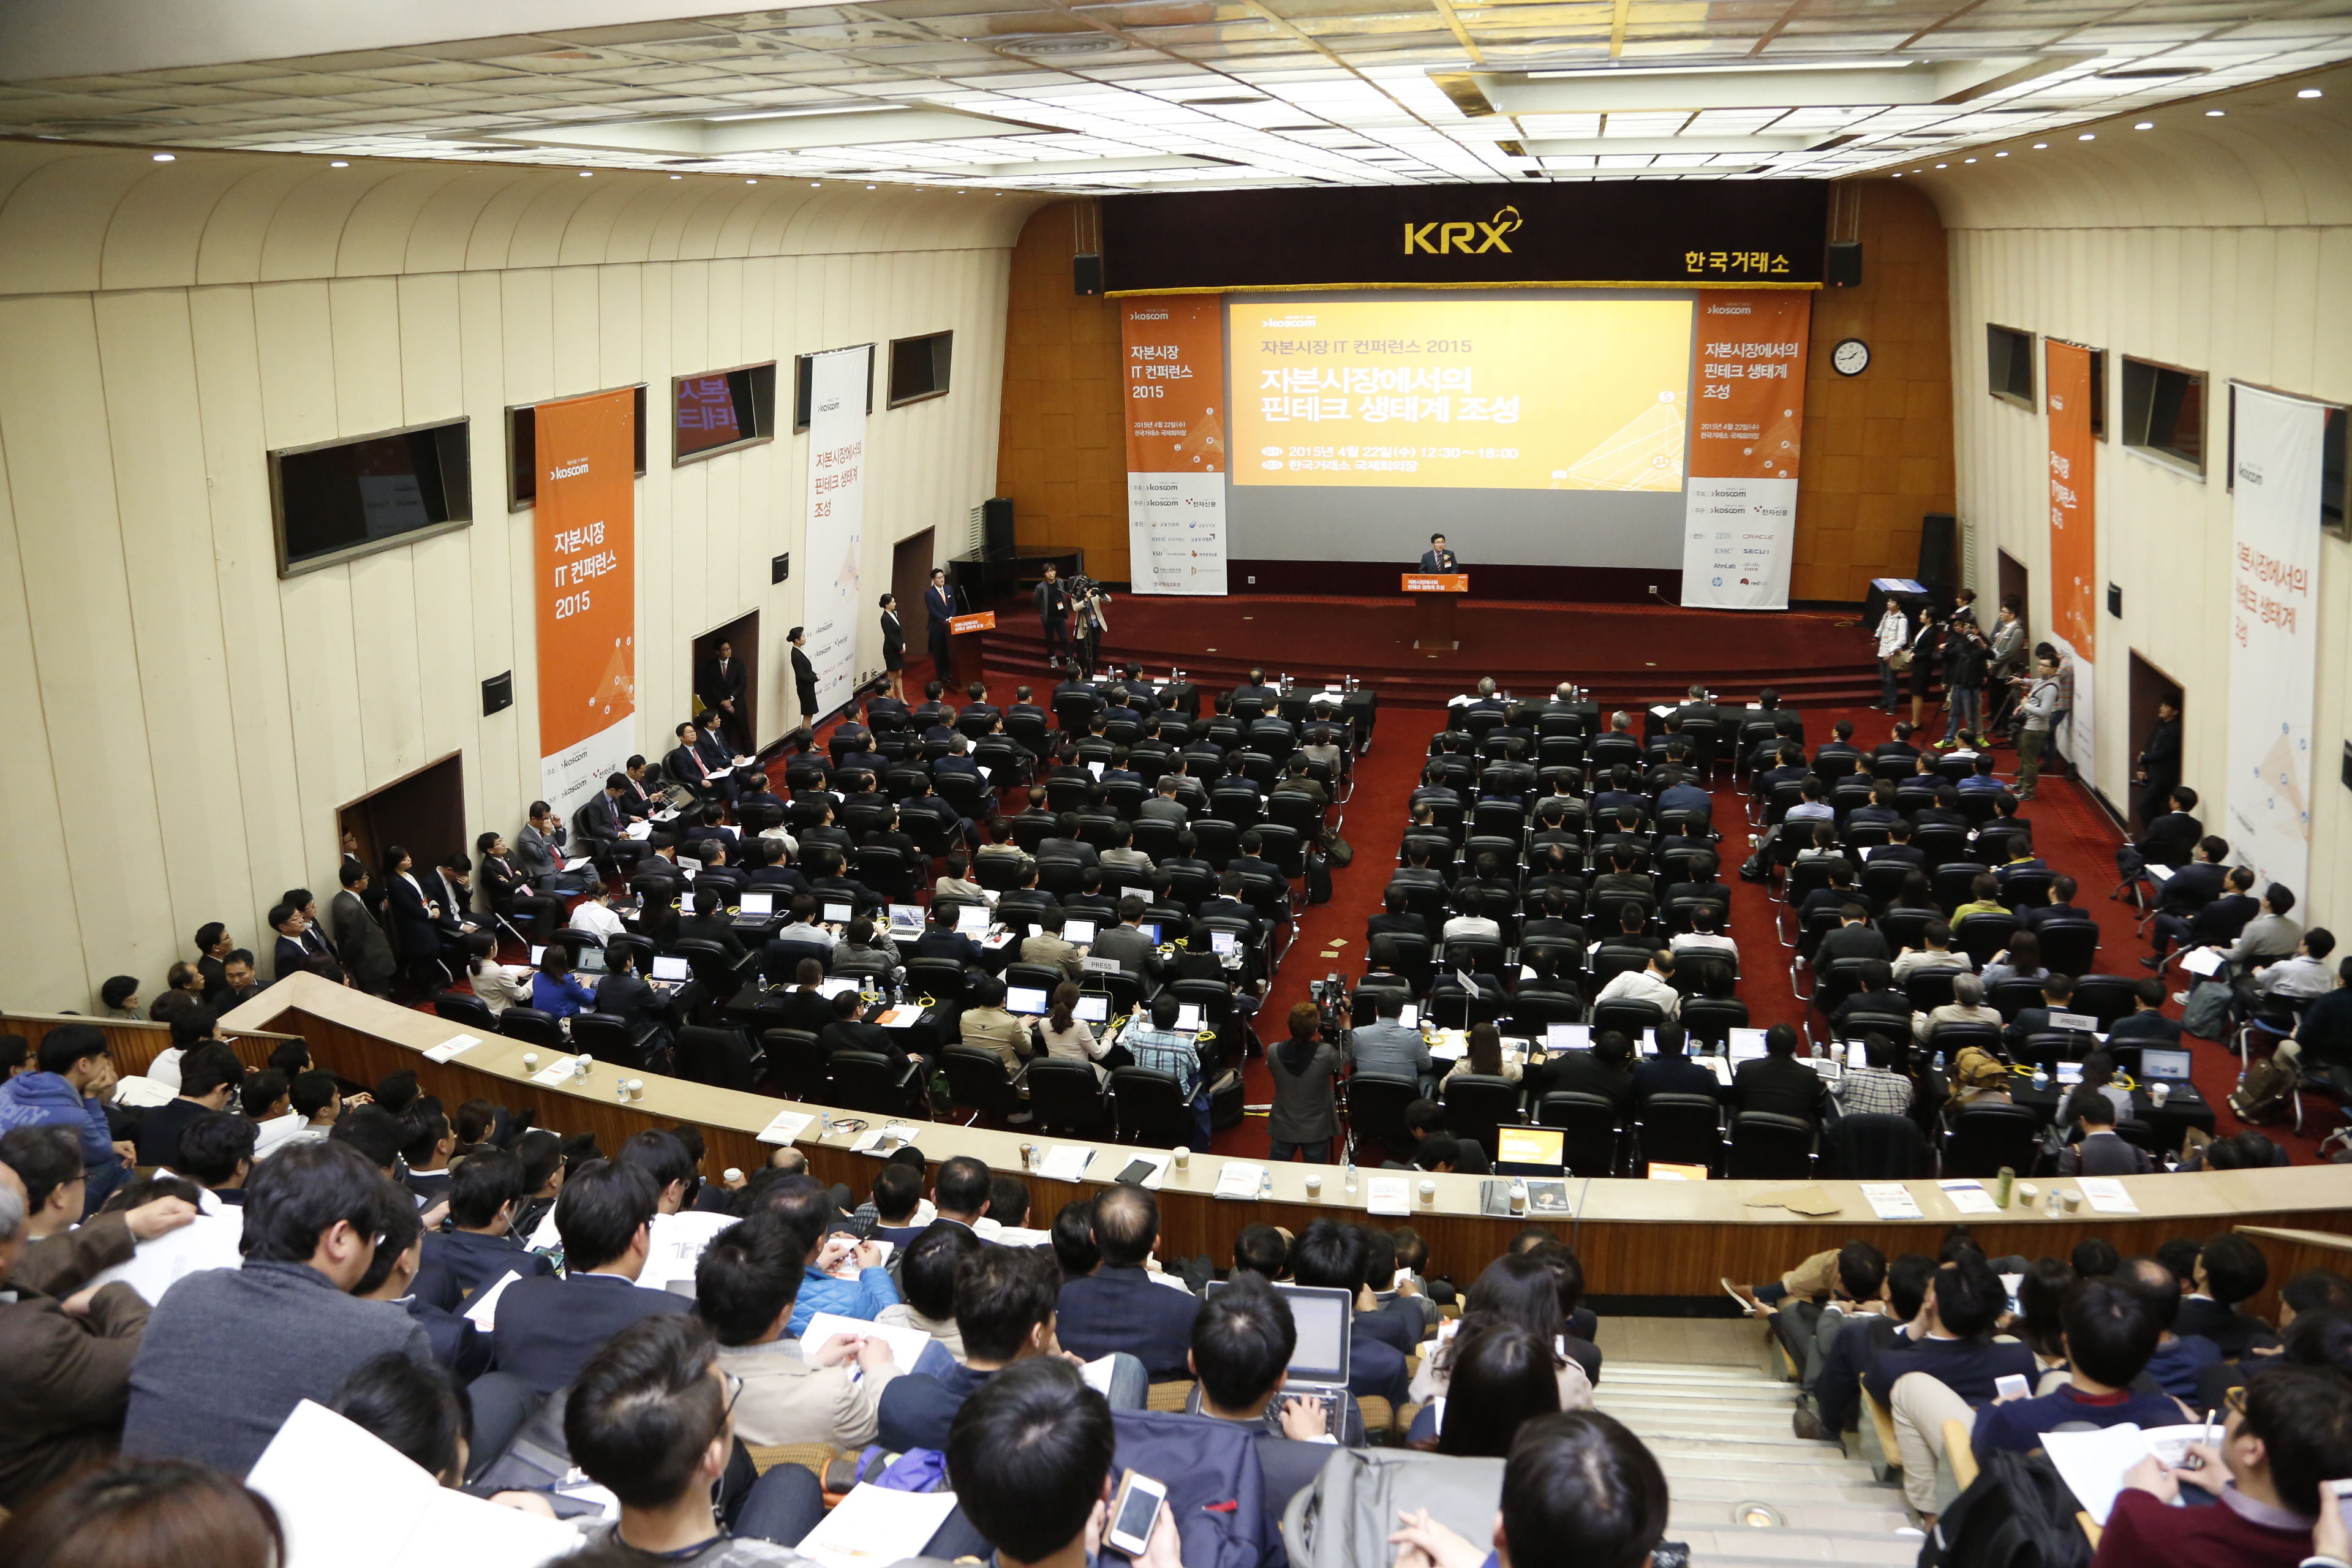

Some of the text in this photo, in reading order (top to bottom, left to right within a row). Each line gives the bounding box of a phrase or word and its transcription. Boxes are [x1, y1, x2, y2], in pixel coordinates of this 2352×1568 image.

[1404, 222, 1513, 255] KRX
[1685, 251, 1790, 273] 한국거래소
[1135, 311, 1168, 320] koscom
[1713, 304, 1751, 314] koscom
[1268, 318, 1316, 328] koscom
[1131, 345, 1179, 360] 자본시장
[1261, 340, 1472, 355] 자본시장 IT 컨퍼런스 2015
[1705, 342, 1798, 358] 자본시장에서의
[1131, 365, 1193, 379] IT 컨퍼런스
[1705, 363, 1788, 379] 핀테크 생태계
[1260, 367, 1471, 394] 자본시장에서의
[1133, 385, 1164, 398] 2015
[1703, 384, 1730, 399] 조성
[820, 401, 840, 412] koscom
[1261, 396, 1520, 424] 핀테크 생태계 조성
[816, 439, 862, 469] 자본시장에서의
[1289, 447, 1334, 458] 2015년
[1338, 446, 1359, 458] 4월
[1363, 447, 1416, 458] 22일(수)
[556, 464, 589, 480] koscom
[1289, 459, 1351, 470] 한국거래소
[1354, 459, 1418, 472] 국제회의장
[815, 465, 858, 495] 핀테크 생태계
[814, 499, 831, 518] 조성
[554, 520, 605, 555] 자본시장
[555, 549, 617, 588] IT 컨퍼런스
[556, 590, 590, 619] 2015
[564, 750, 588, 768] koscom
[599, 764, 616, 778] 전자신문
[564, 778, 587, 797] koscom
[2061, 1018, 2087, 1027] PRESS
